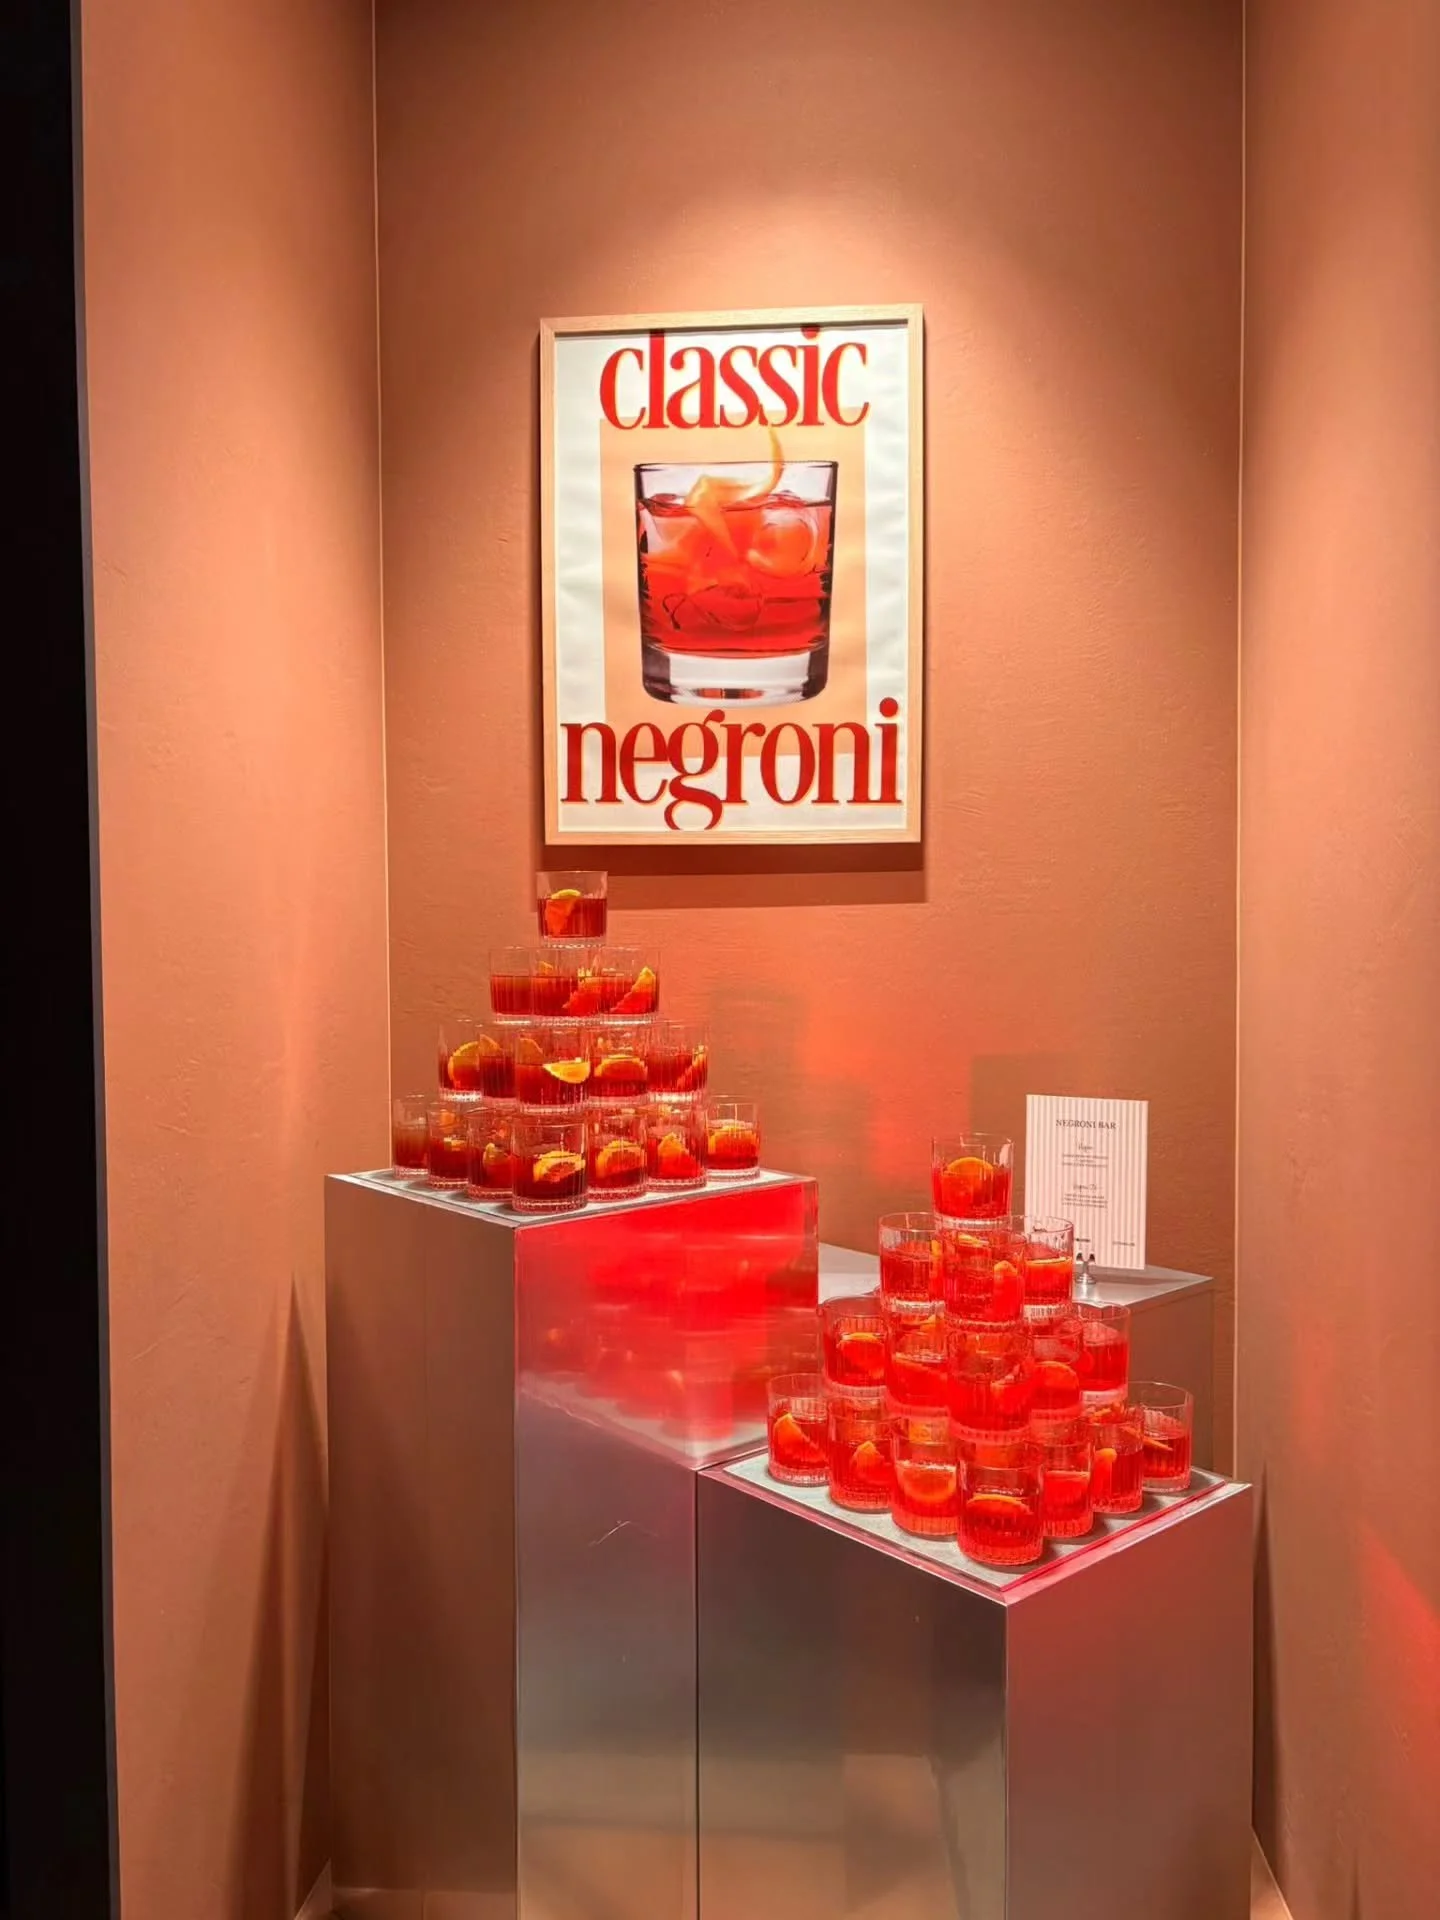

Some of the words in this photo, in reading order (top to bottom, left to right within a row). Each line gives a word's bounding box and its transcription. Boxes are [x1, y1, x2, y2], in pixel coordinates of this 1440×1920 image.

[600, 323, 869, 430] classic
[560, 696, 902, 830] negroni
[1056, 1119, 1096, 1129] NEGRONI
[1098, 1121, 1117, 1130] BAR
